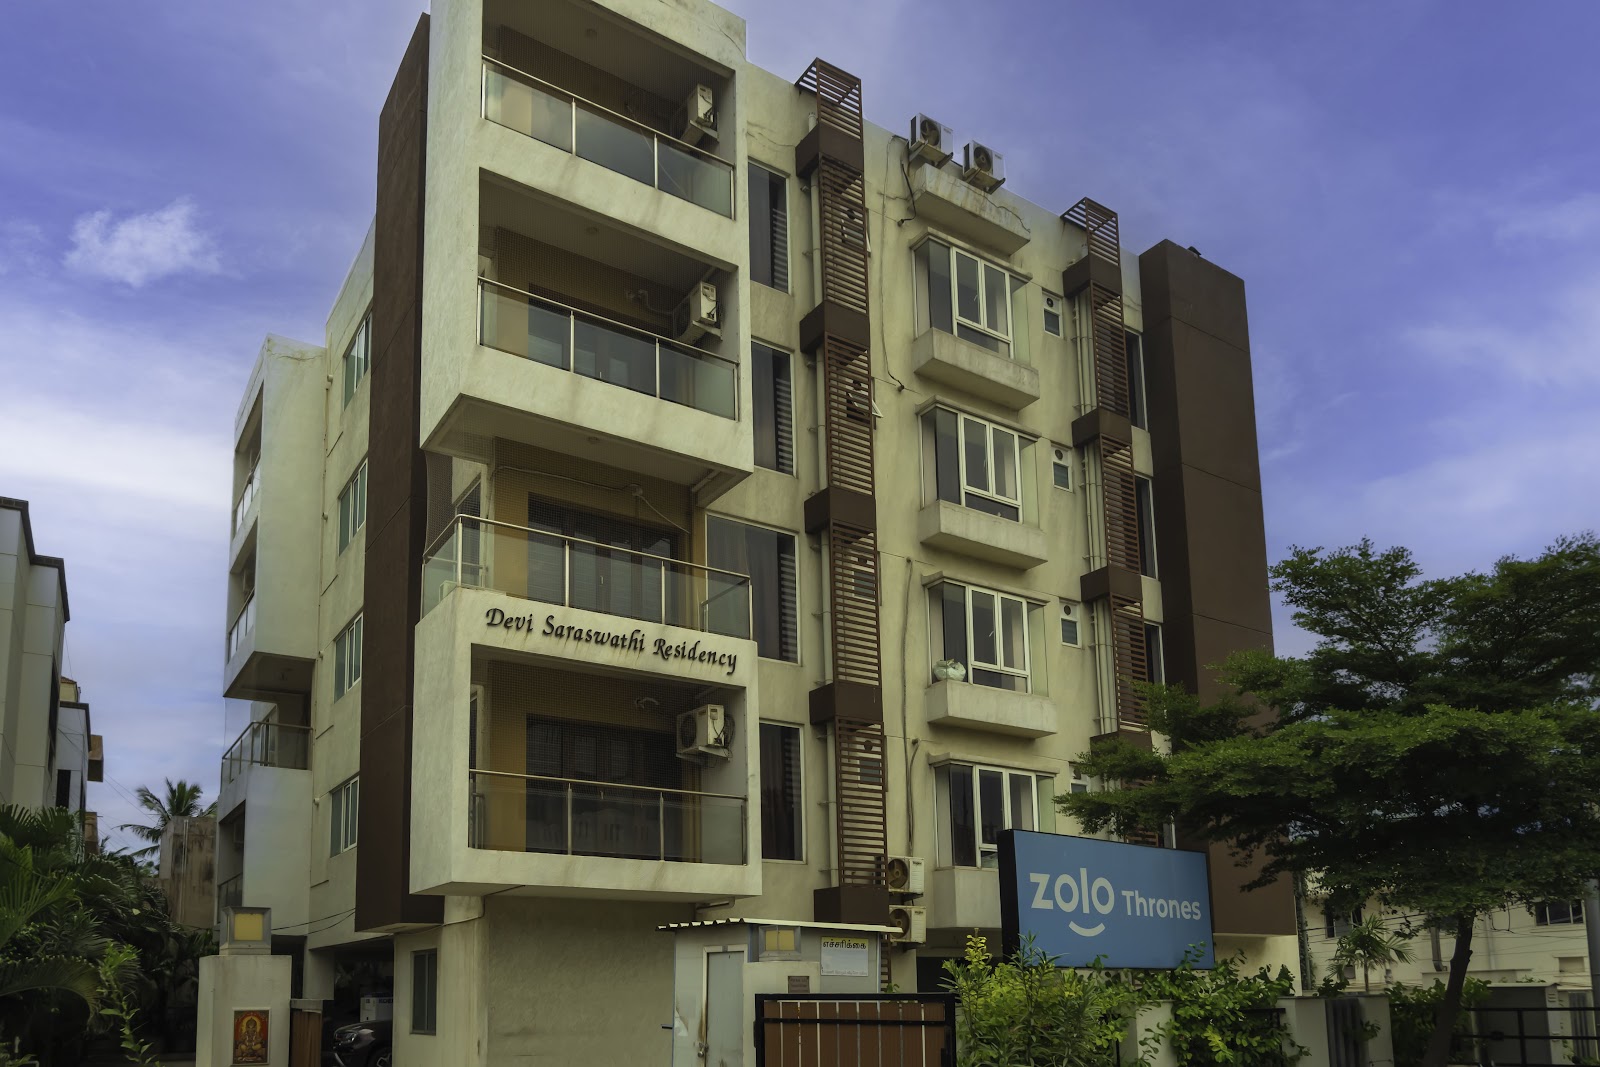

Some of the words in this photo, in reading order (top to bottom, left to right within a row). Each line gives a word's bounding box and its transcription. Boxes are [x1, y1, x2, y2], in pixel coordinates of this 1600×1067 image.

[485, 607, 534, 633] Devi
[542, 614, 646, 652] Saraswathi
[652, 637, 738, 676] Residency
[1121, 889, 1201, 921] Thrones
